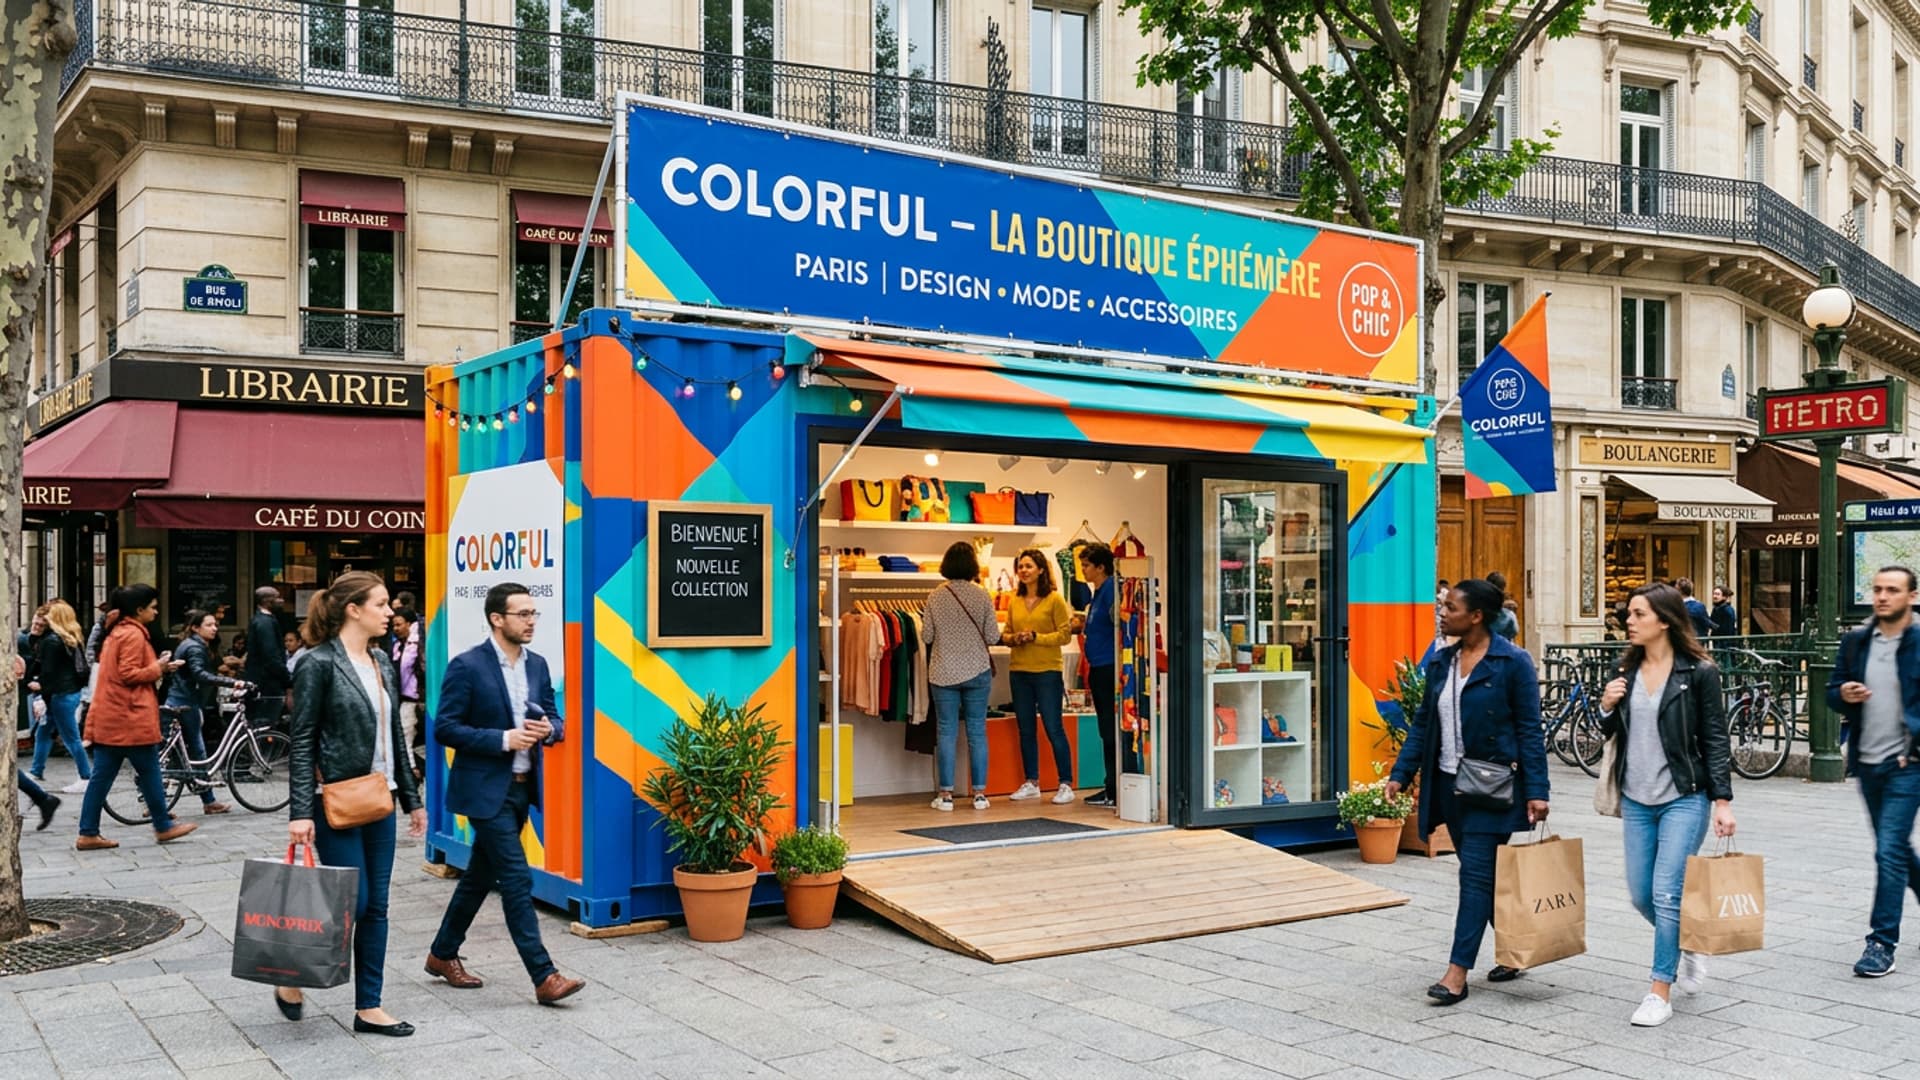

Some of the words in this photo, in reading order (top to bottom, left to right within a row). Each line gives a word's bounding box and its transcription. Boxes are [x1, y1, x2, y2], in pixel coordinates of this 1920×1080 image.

[318, 210, 389, 227] LIBRAIRIE
[660, 156, 938, 242] COLORFUL
[990, 209, 1026, 255] LA
[1036, 217, 1178, 278] BOUTIQUE
[1186, 233, 1321, 300] ÉPHÉMÈRE
[795, 252, 870, 286] PARIS
[900, 266, 991, 301] DESIGN
[1012, 281, 1082, 313] MODE
[1100, 294, 1238, 333] ACCESSOIRES
[1351, 282, 1380, 308] POP
[1381, 288, 1392, 310] &
[1352, 308, 1390, 338] CHIC
[200, 366, 409, 407] LIBRAIRIE
[1471, 411, 1546, 433] COLORFUL
[1603, 444, 1717, 464] BOULANGERIE
[255, 504, 319, 527] CAFÉ
[325, 509, 361, 528] DU
[367, 509, 426, 529] COIN
[671, 523, 748, 543] BIENVENUE
[455, 528, 554, 572] COLORFUL
[676, 558, 741, 575] NOUVELLE
[671, 581, 748, 597] COLLECTION
[244, 911, 325, 934] MONOPRIX
